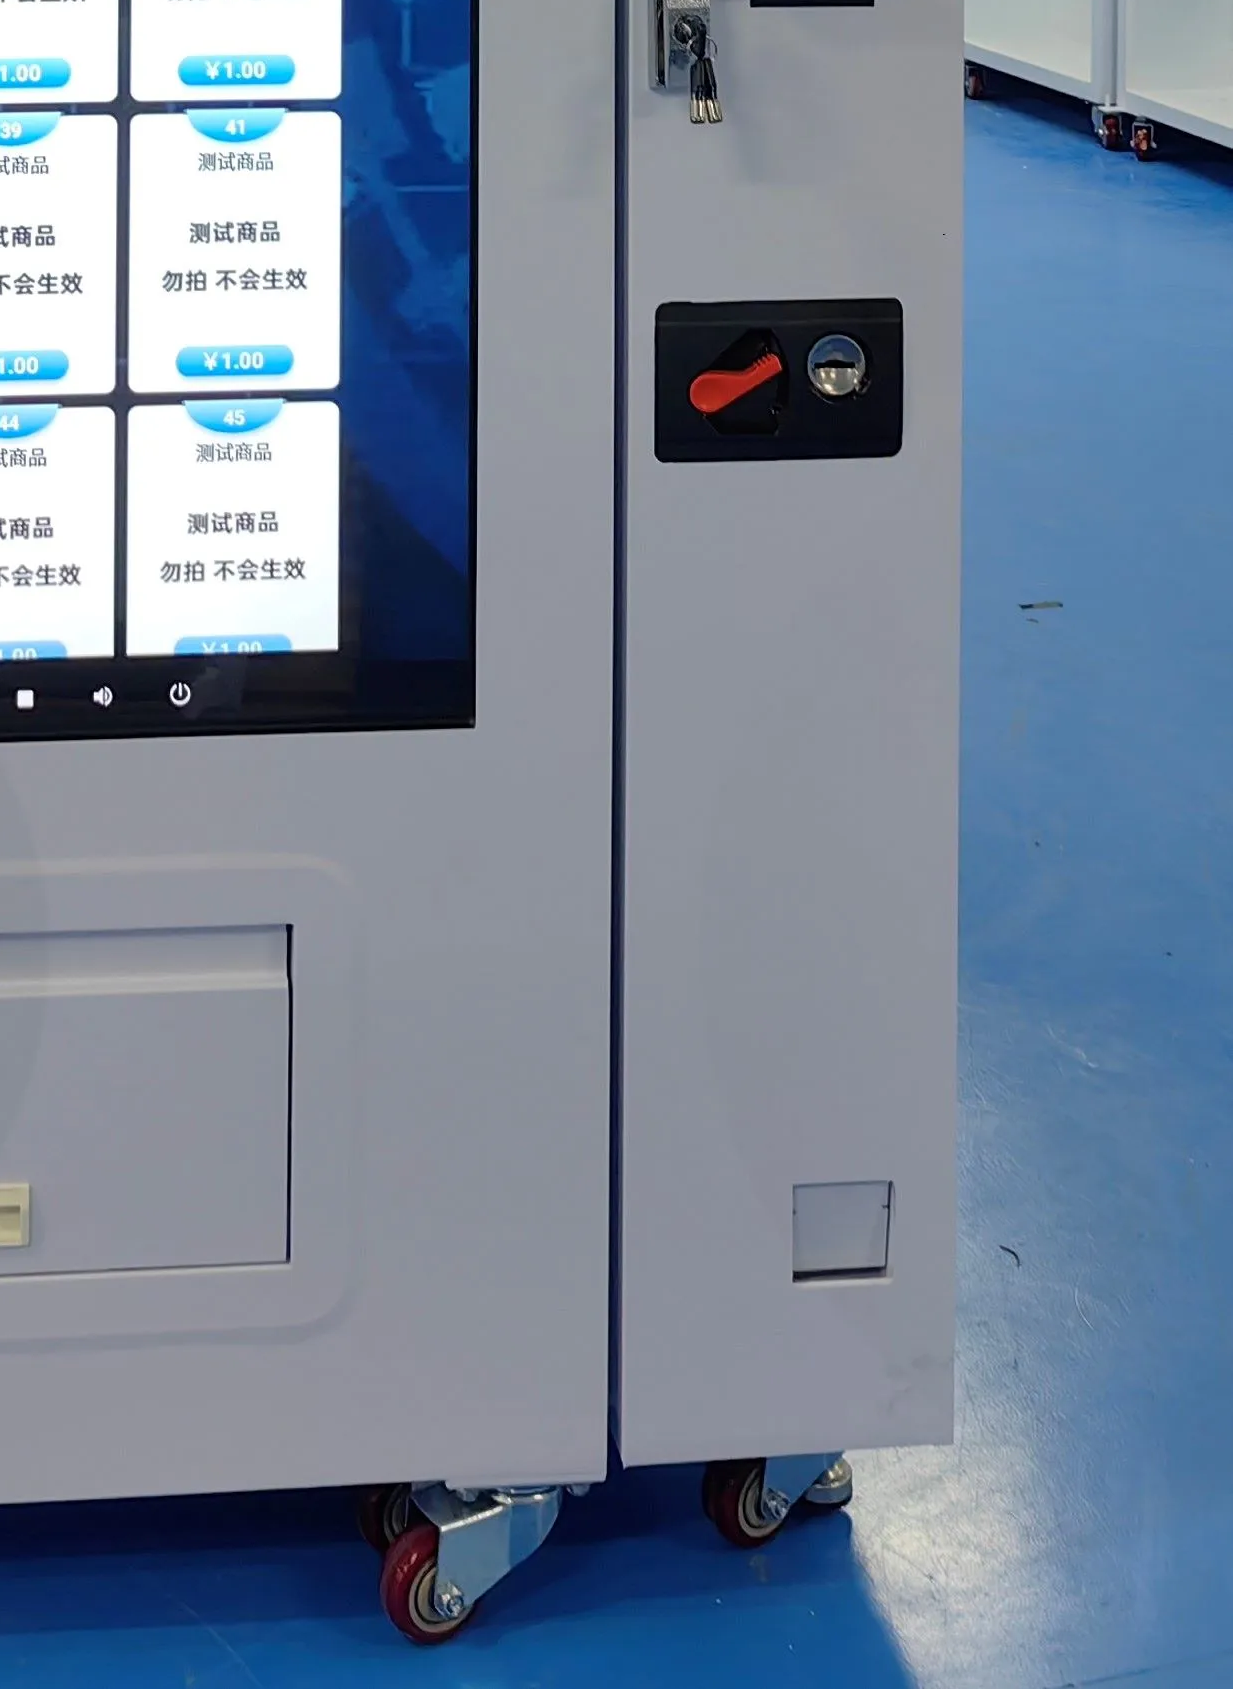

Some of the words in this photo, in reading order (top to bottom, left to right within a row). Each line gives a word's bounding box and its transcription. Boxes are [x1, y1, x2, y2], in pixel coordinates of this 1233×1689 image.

[0, 123, 22, 140] 39
[224, 119, 246, 136] 41
[198, 151, 274, 172] 测试商品
[190, 221, 280, 243] 测试商品
[162, 270, 206, 292] 勿拍
[216, 268, 307, 290] 不会生效
[222, 409, 245, 426] 45
[196, 442, 272, 463] 测试商品
[188, 512, 278, 534] 测试商品
[161, 561, 204, 582] 勿拍
[214, 559, 305, 580] 不会生效
